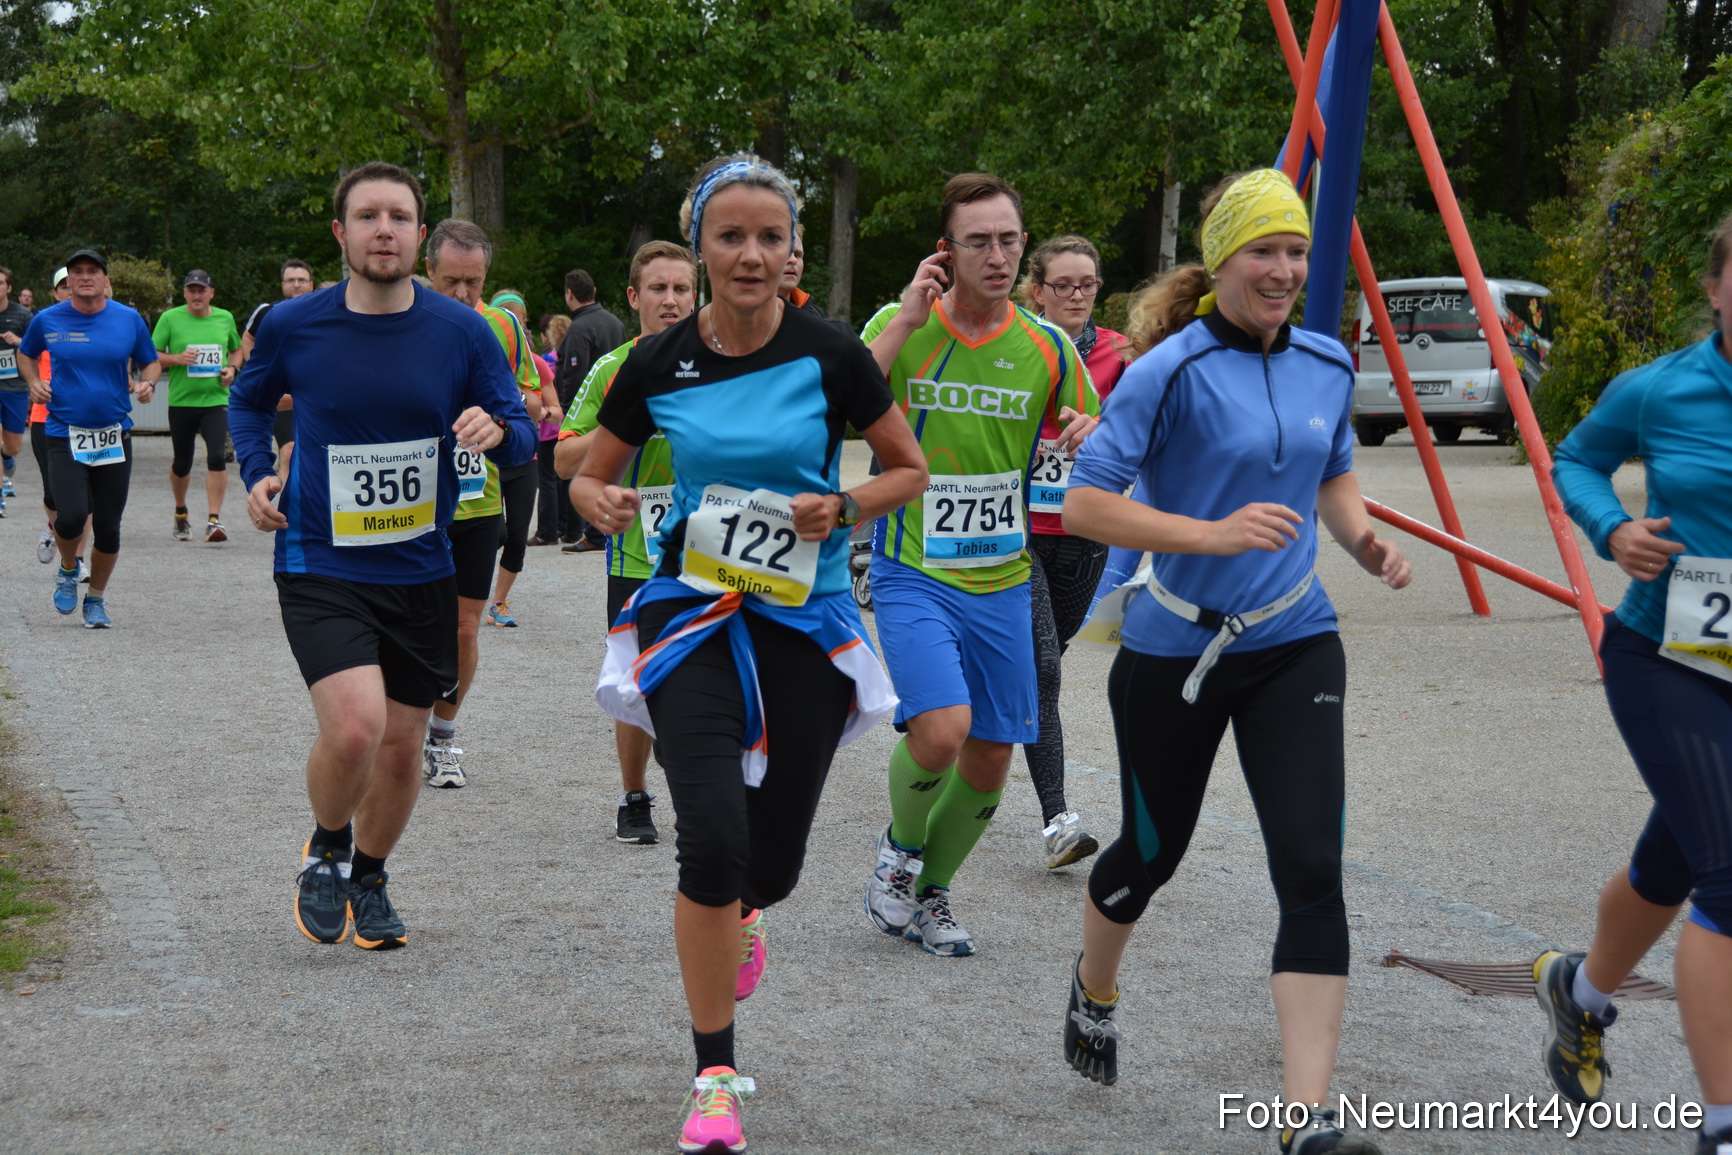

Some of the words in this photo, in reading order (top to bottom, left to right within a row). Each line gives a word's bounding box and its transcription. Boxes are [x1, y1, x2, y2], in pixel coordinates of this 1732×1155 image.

[907, 378, 1033, 420] BOCK
[76, 430, 117, 450] 2196
[331, 455, 369, 465] PARTL
[370, 451, 423, 464] Neumarkt
[353, 465, 421, 507] 356
[641, 486, 671, 501] PARTL
[926, 484, 962, 494] PARTL
[964, 482, 1009, 494] Neumarkt
[363, 514, 415, 531] Markus
[935, 495, 1015, 533] 2754
[720, 513, 797, 573] 122
[954, 541, 998, 556] Tobias
[1674, 569, 1725, 585] PARTL
[1700, 591, 1731, 639] 2
